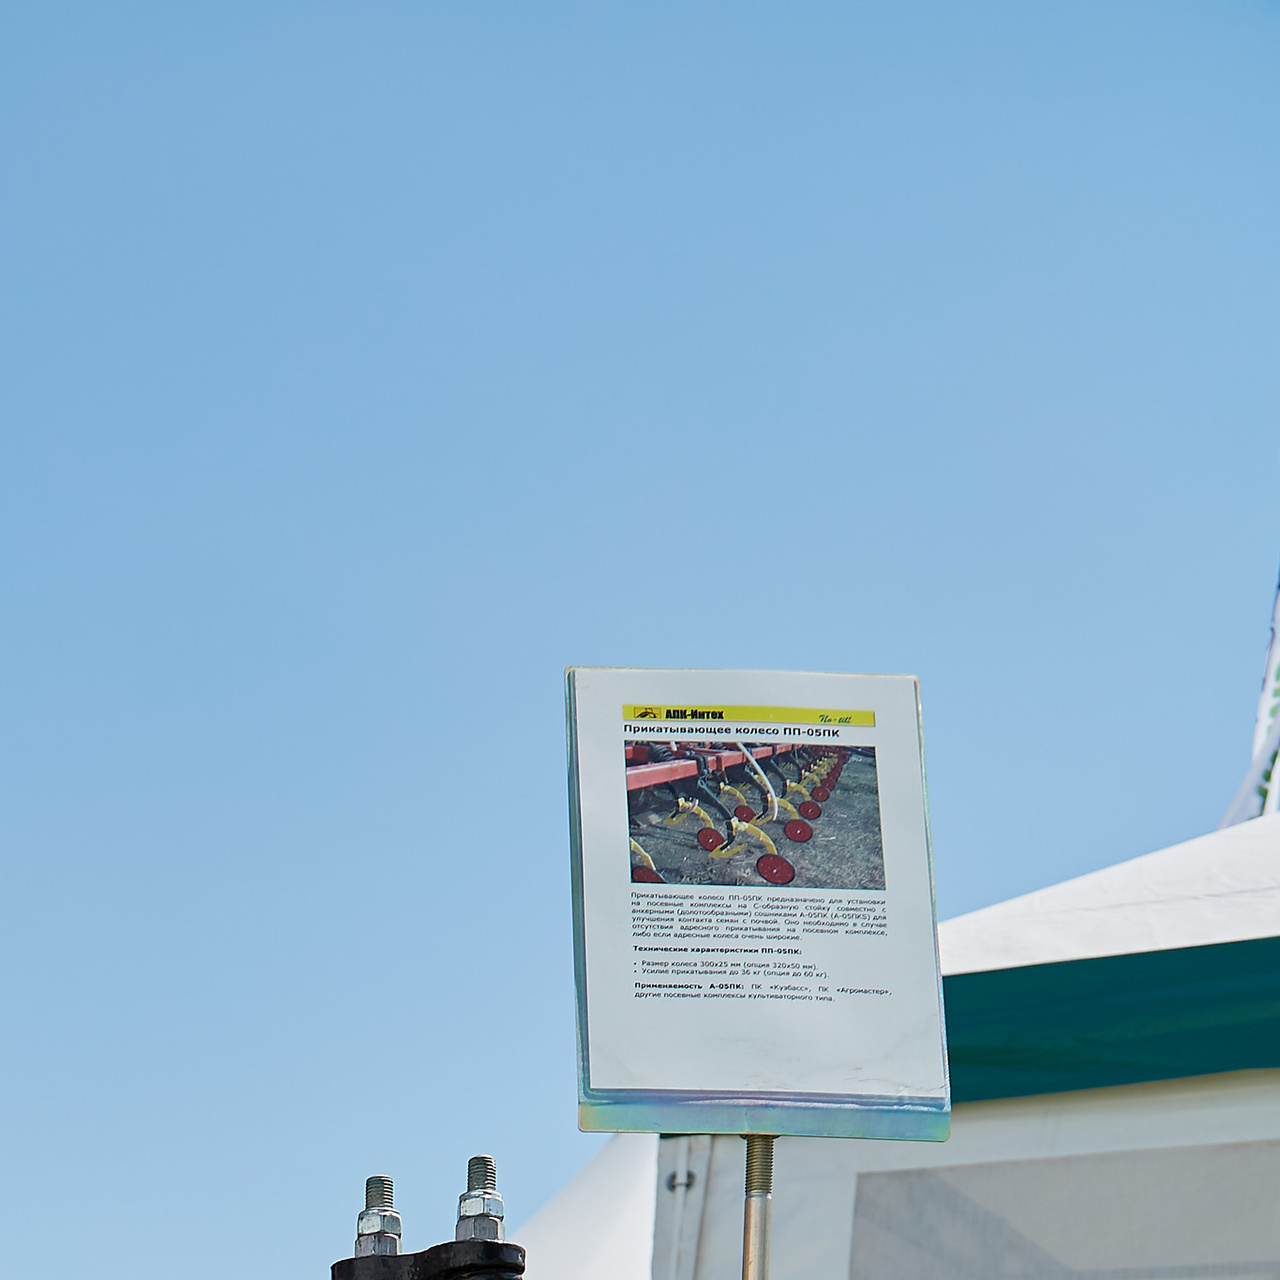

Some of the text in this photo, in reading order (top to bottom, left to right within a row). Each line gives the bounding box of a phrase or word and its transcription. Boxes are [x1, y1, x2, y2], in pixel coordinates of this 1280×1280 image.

[665, 710, 724, 720] АПК-Интех
[624, 725, 731, 735] Прикатывающее
[784, 728, 839, 737] ПП-05ПК
[677, 909, 752, 918] (долотообразными)
